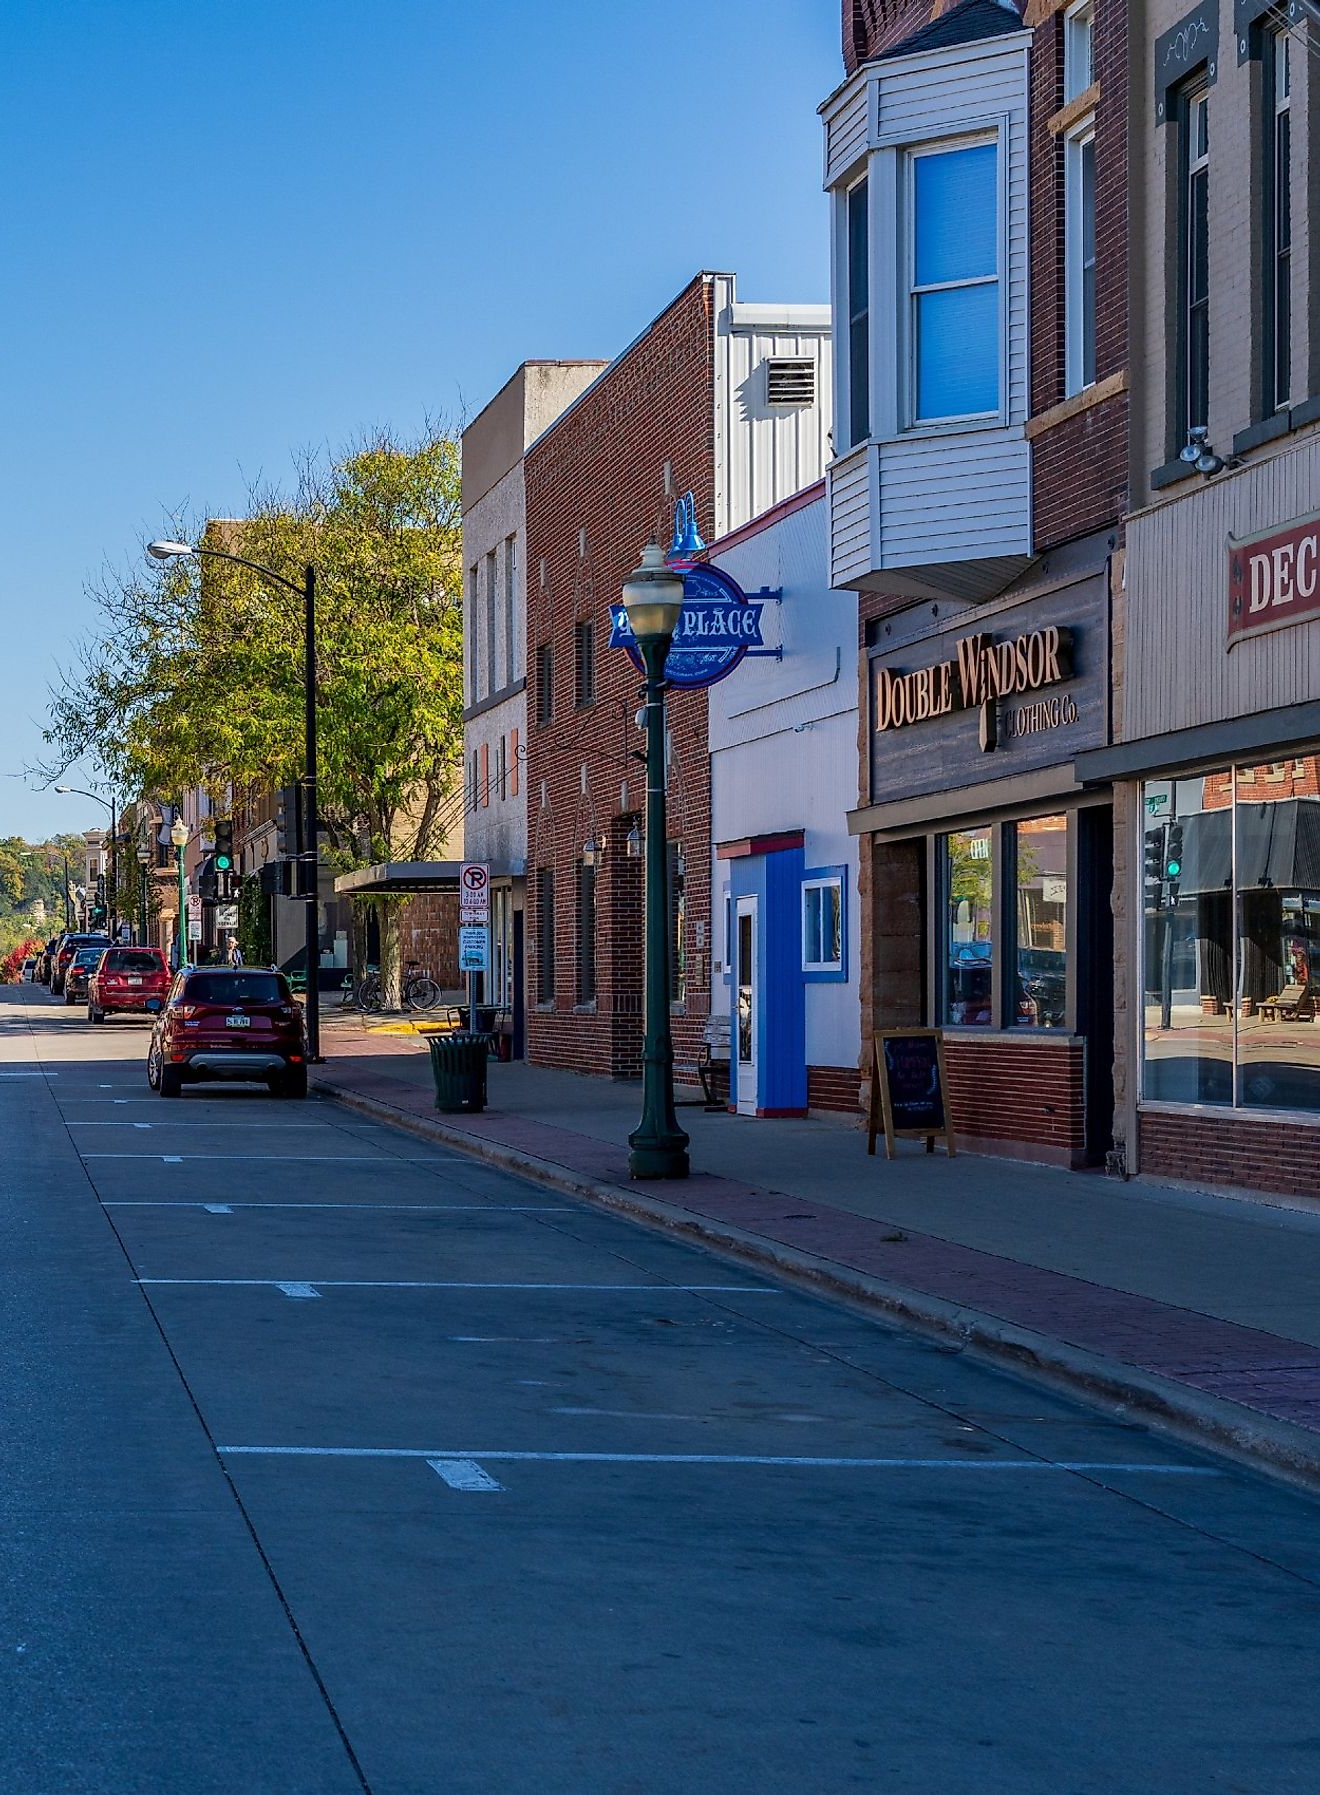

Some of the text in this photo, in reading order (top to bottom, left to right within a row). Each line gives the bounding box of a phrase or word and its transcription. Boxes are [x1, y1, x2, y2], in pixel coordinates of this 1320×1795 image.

[1249, 535, 1317, 613] DEC
[682, 607, 758, 638] PLACE
[876, 660, 953, 732] DOUBLE
[1005, 697, 1059, 738] CLOTHING
